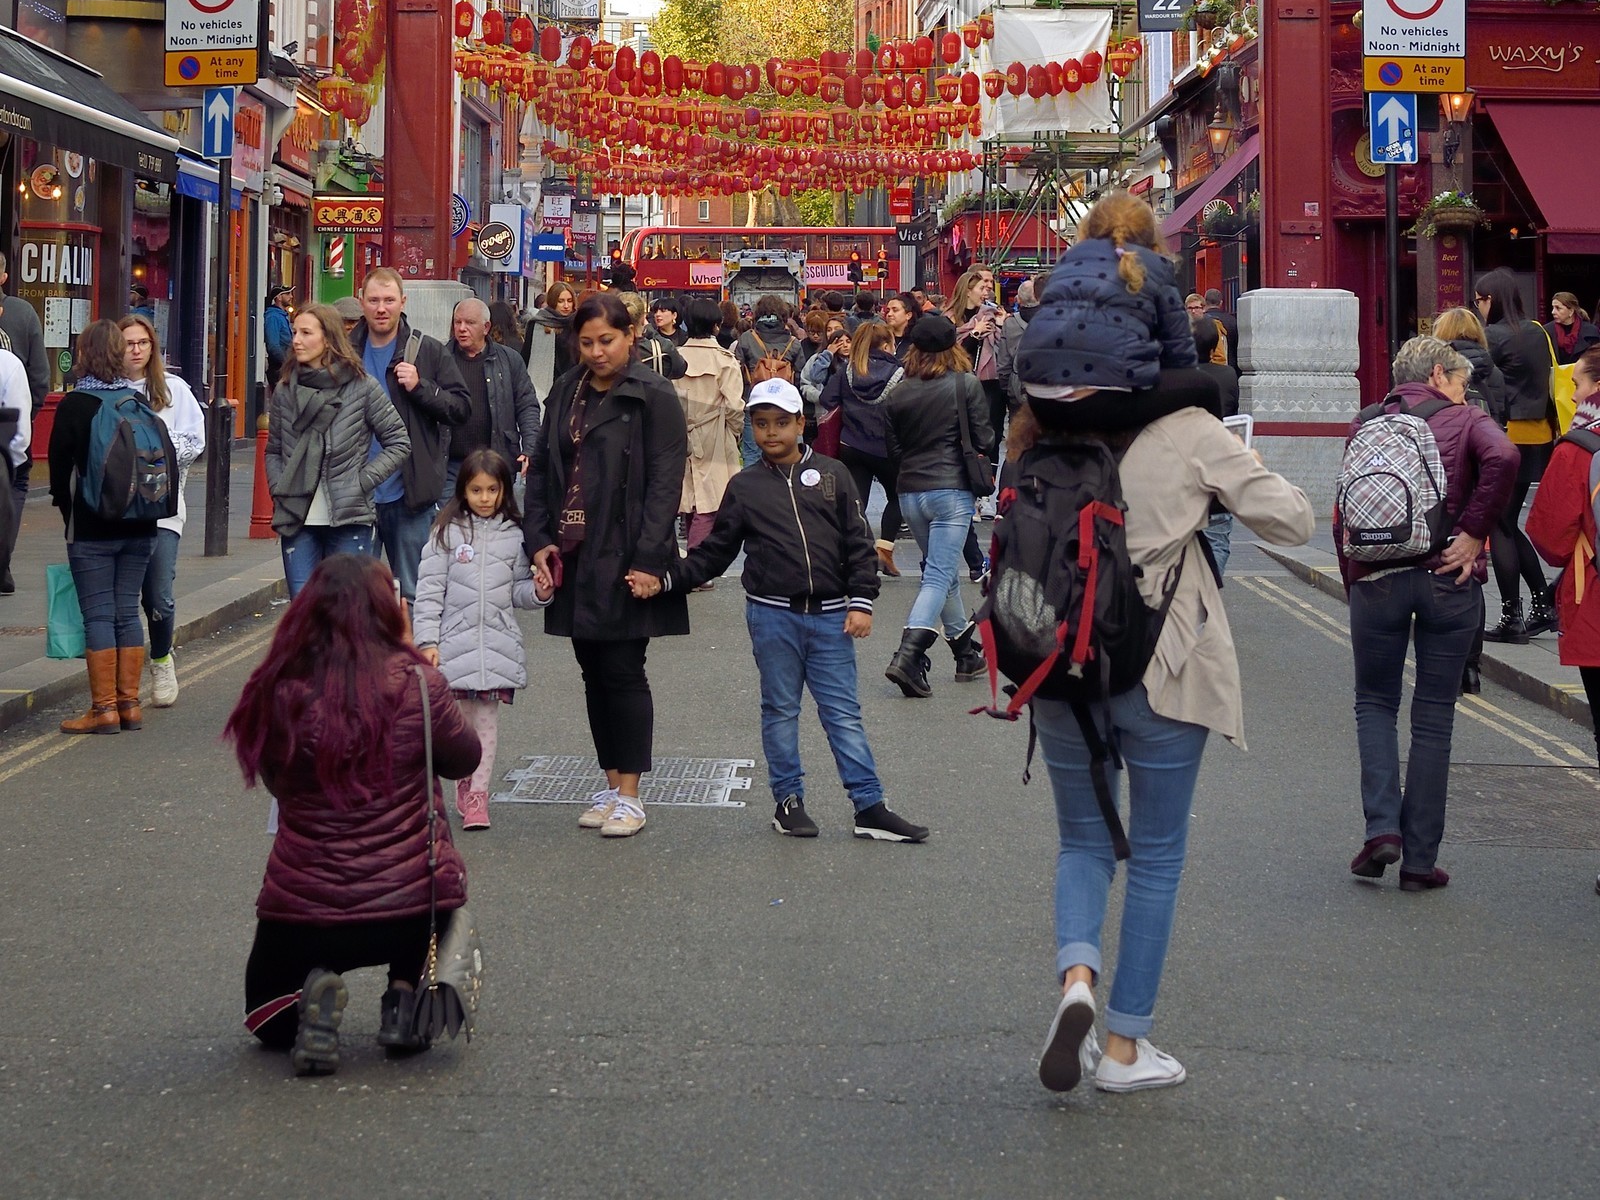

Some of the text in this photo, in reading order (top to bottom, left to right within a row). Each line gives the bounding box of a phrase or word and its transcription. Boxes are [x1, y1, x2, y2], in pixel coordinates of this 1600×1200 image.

[180, 19, 243, 31] No vehicles
[1380, 26, 1449, 36] No vehicles
[170, 36, 198, 46] Noon
[206, 34, 253, 47] Midnight
[1369, 41, 1400, 51] Noon
[1409, 41, 1461, 53] Midnight
[210, 57, 244, 68] At any
[215, 69, 239, 78] time
[1413, 64, 1451, 76] At any
[1419, 76, 1445, 86] time
[320, 208, 378, 222] 文興酒家
[544, 218, 560, 226] Wong
[899, 228, 924, 241] Viet
[21, 243, 92, 286] CHALIN
[1441, 268, 1460, 276] Wine
[643, 276, 657, 286] Go
[691, 275, 722, 284] When
[18, 288, 45, 298] FROM
[1440, 283, 1462, 294] Coffee
[1360, 532, 1392, 540] Kappa
